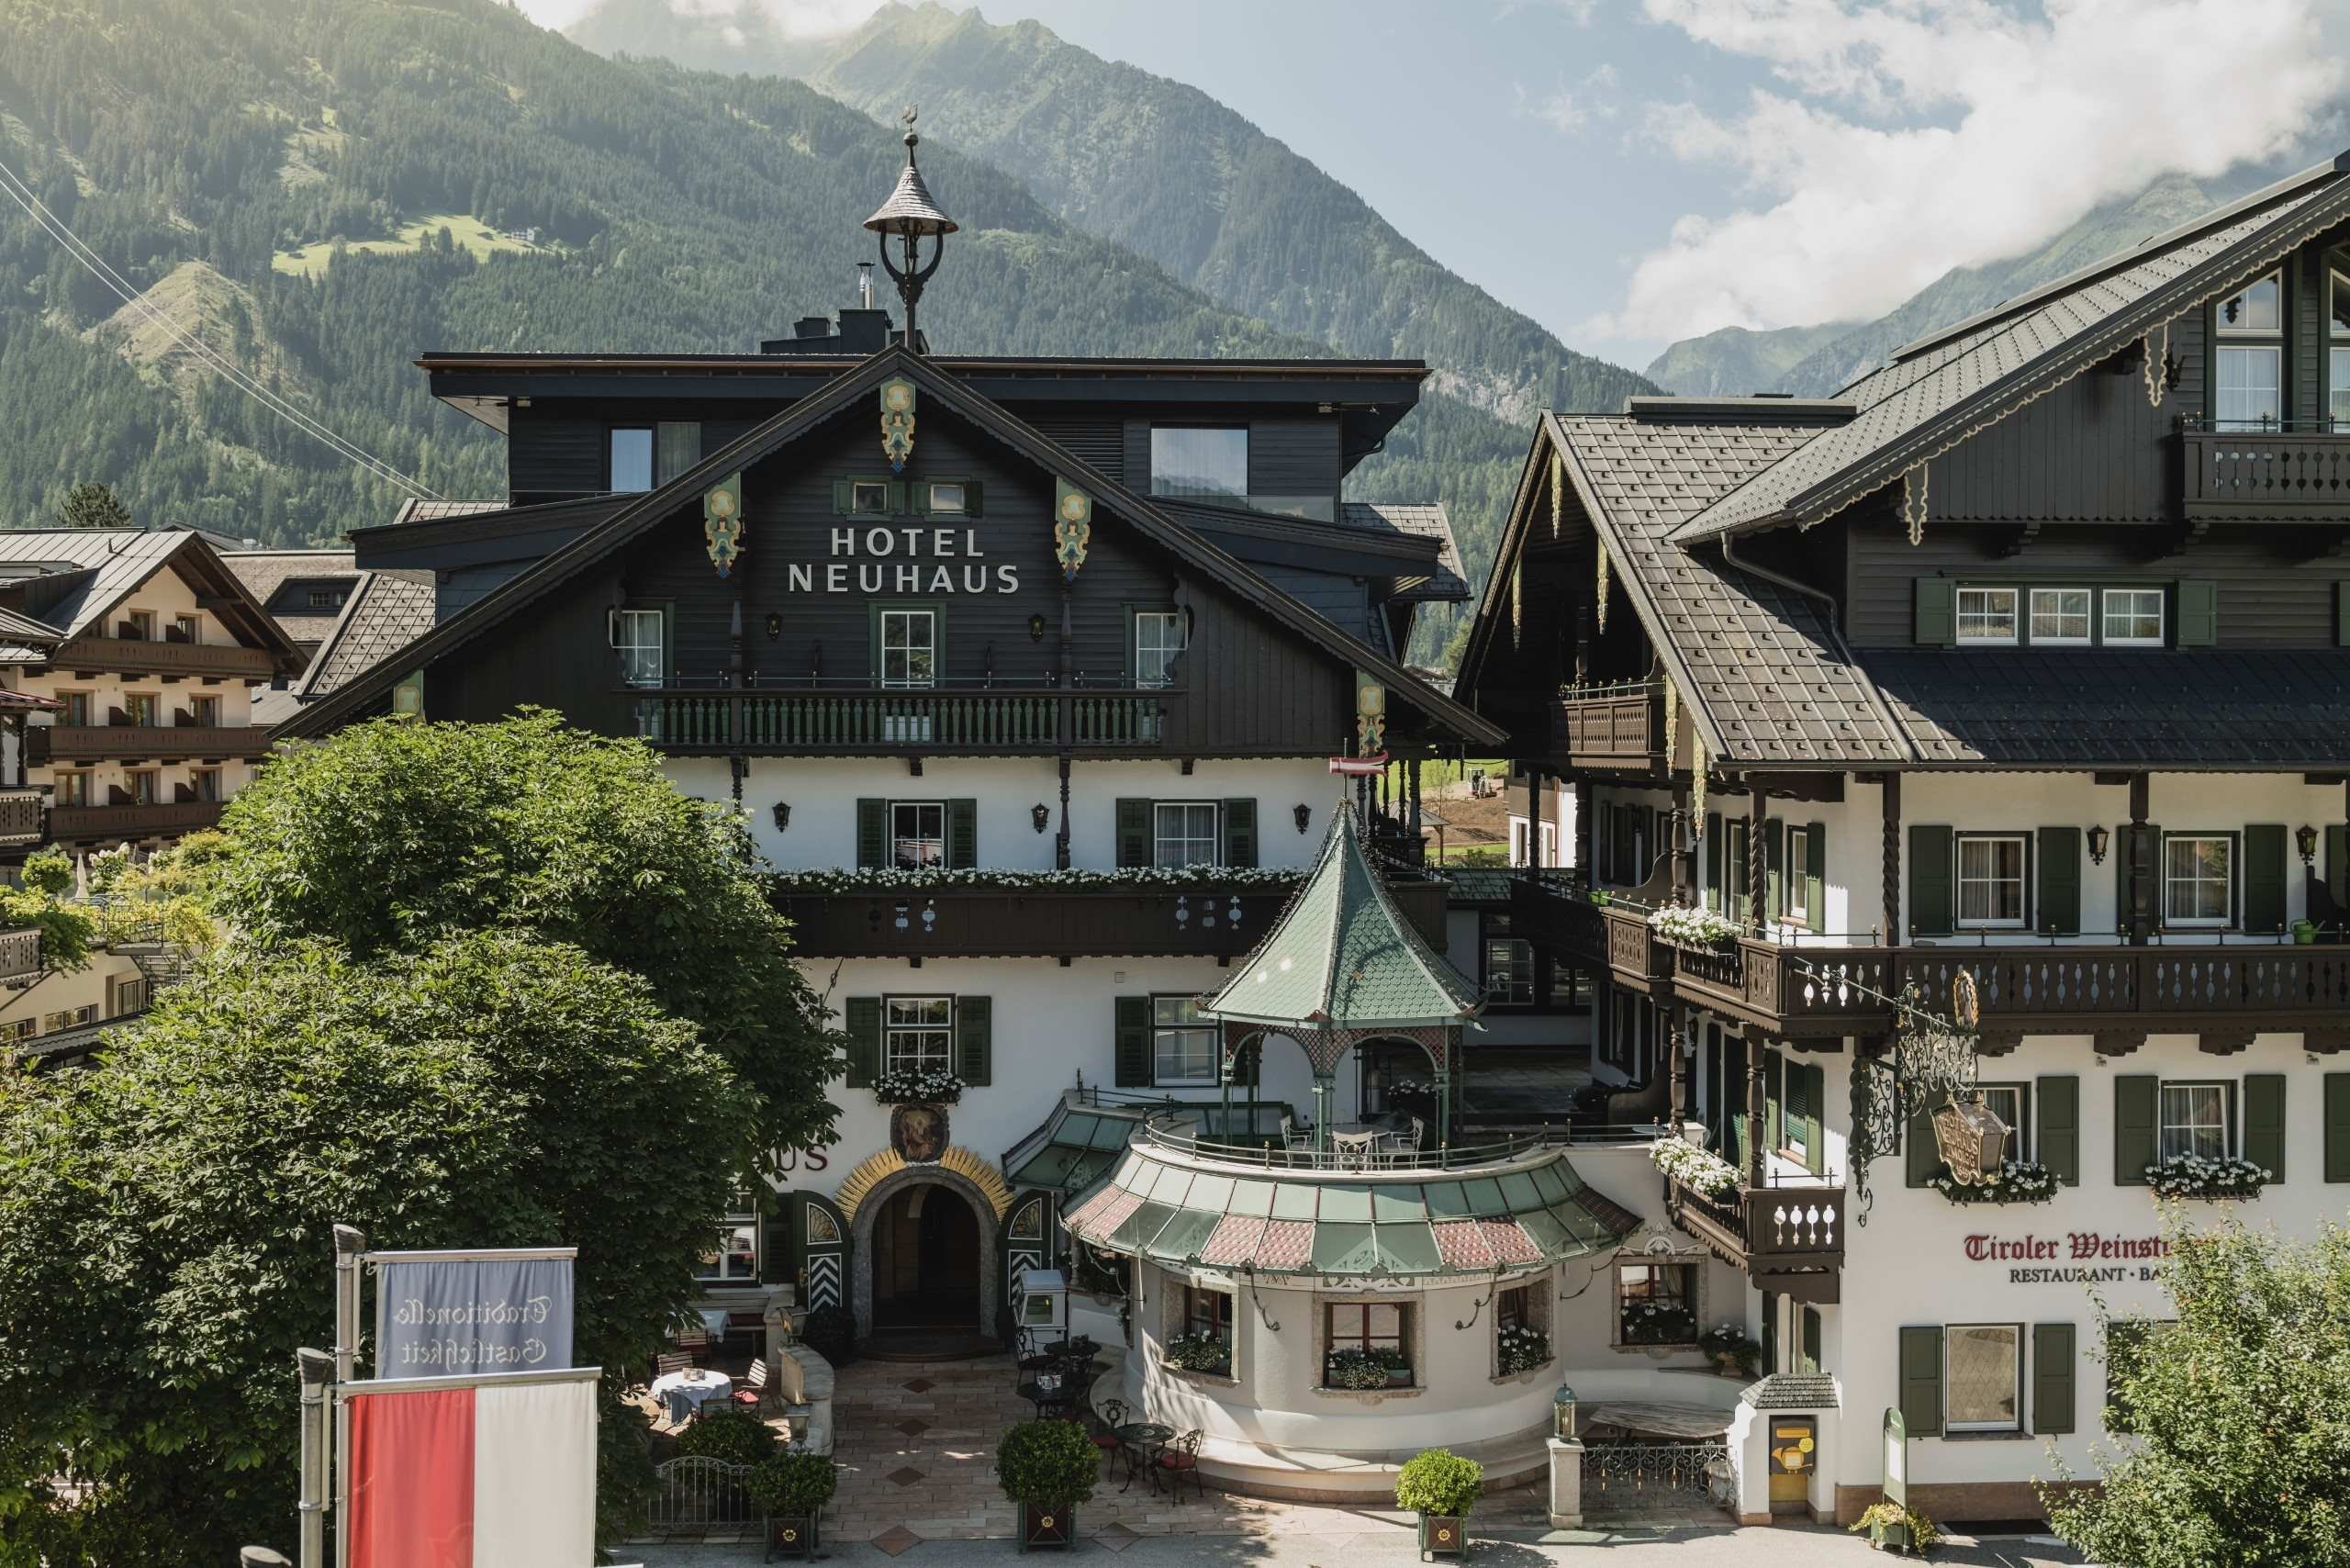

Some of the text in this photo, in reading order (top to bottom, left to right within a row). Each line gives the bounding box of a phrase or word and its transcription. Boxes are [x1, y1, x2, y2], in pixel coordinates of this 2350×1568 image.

[831, 527, 984, 557] HOTEL
[788, 563, 1020, 594] NEUHAUS
[1964, 1234, 2060, 1261] Tiroler
[2009, 1268, 2127, 1283] RESTAURANT
